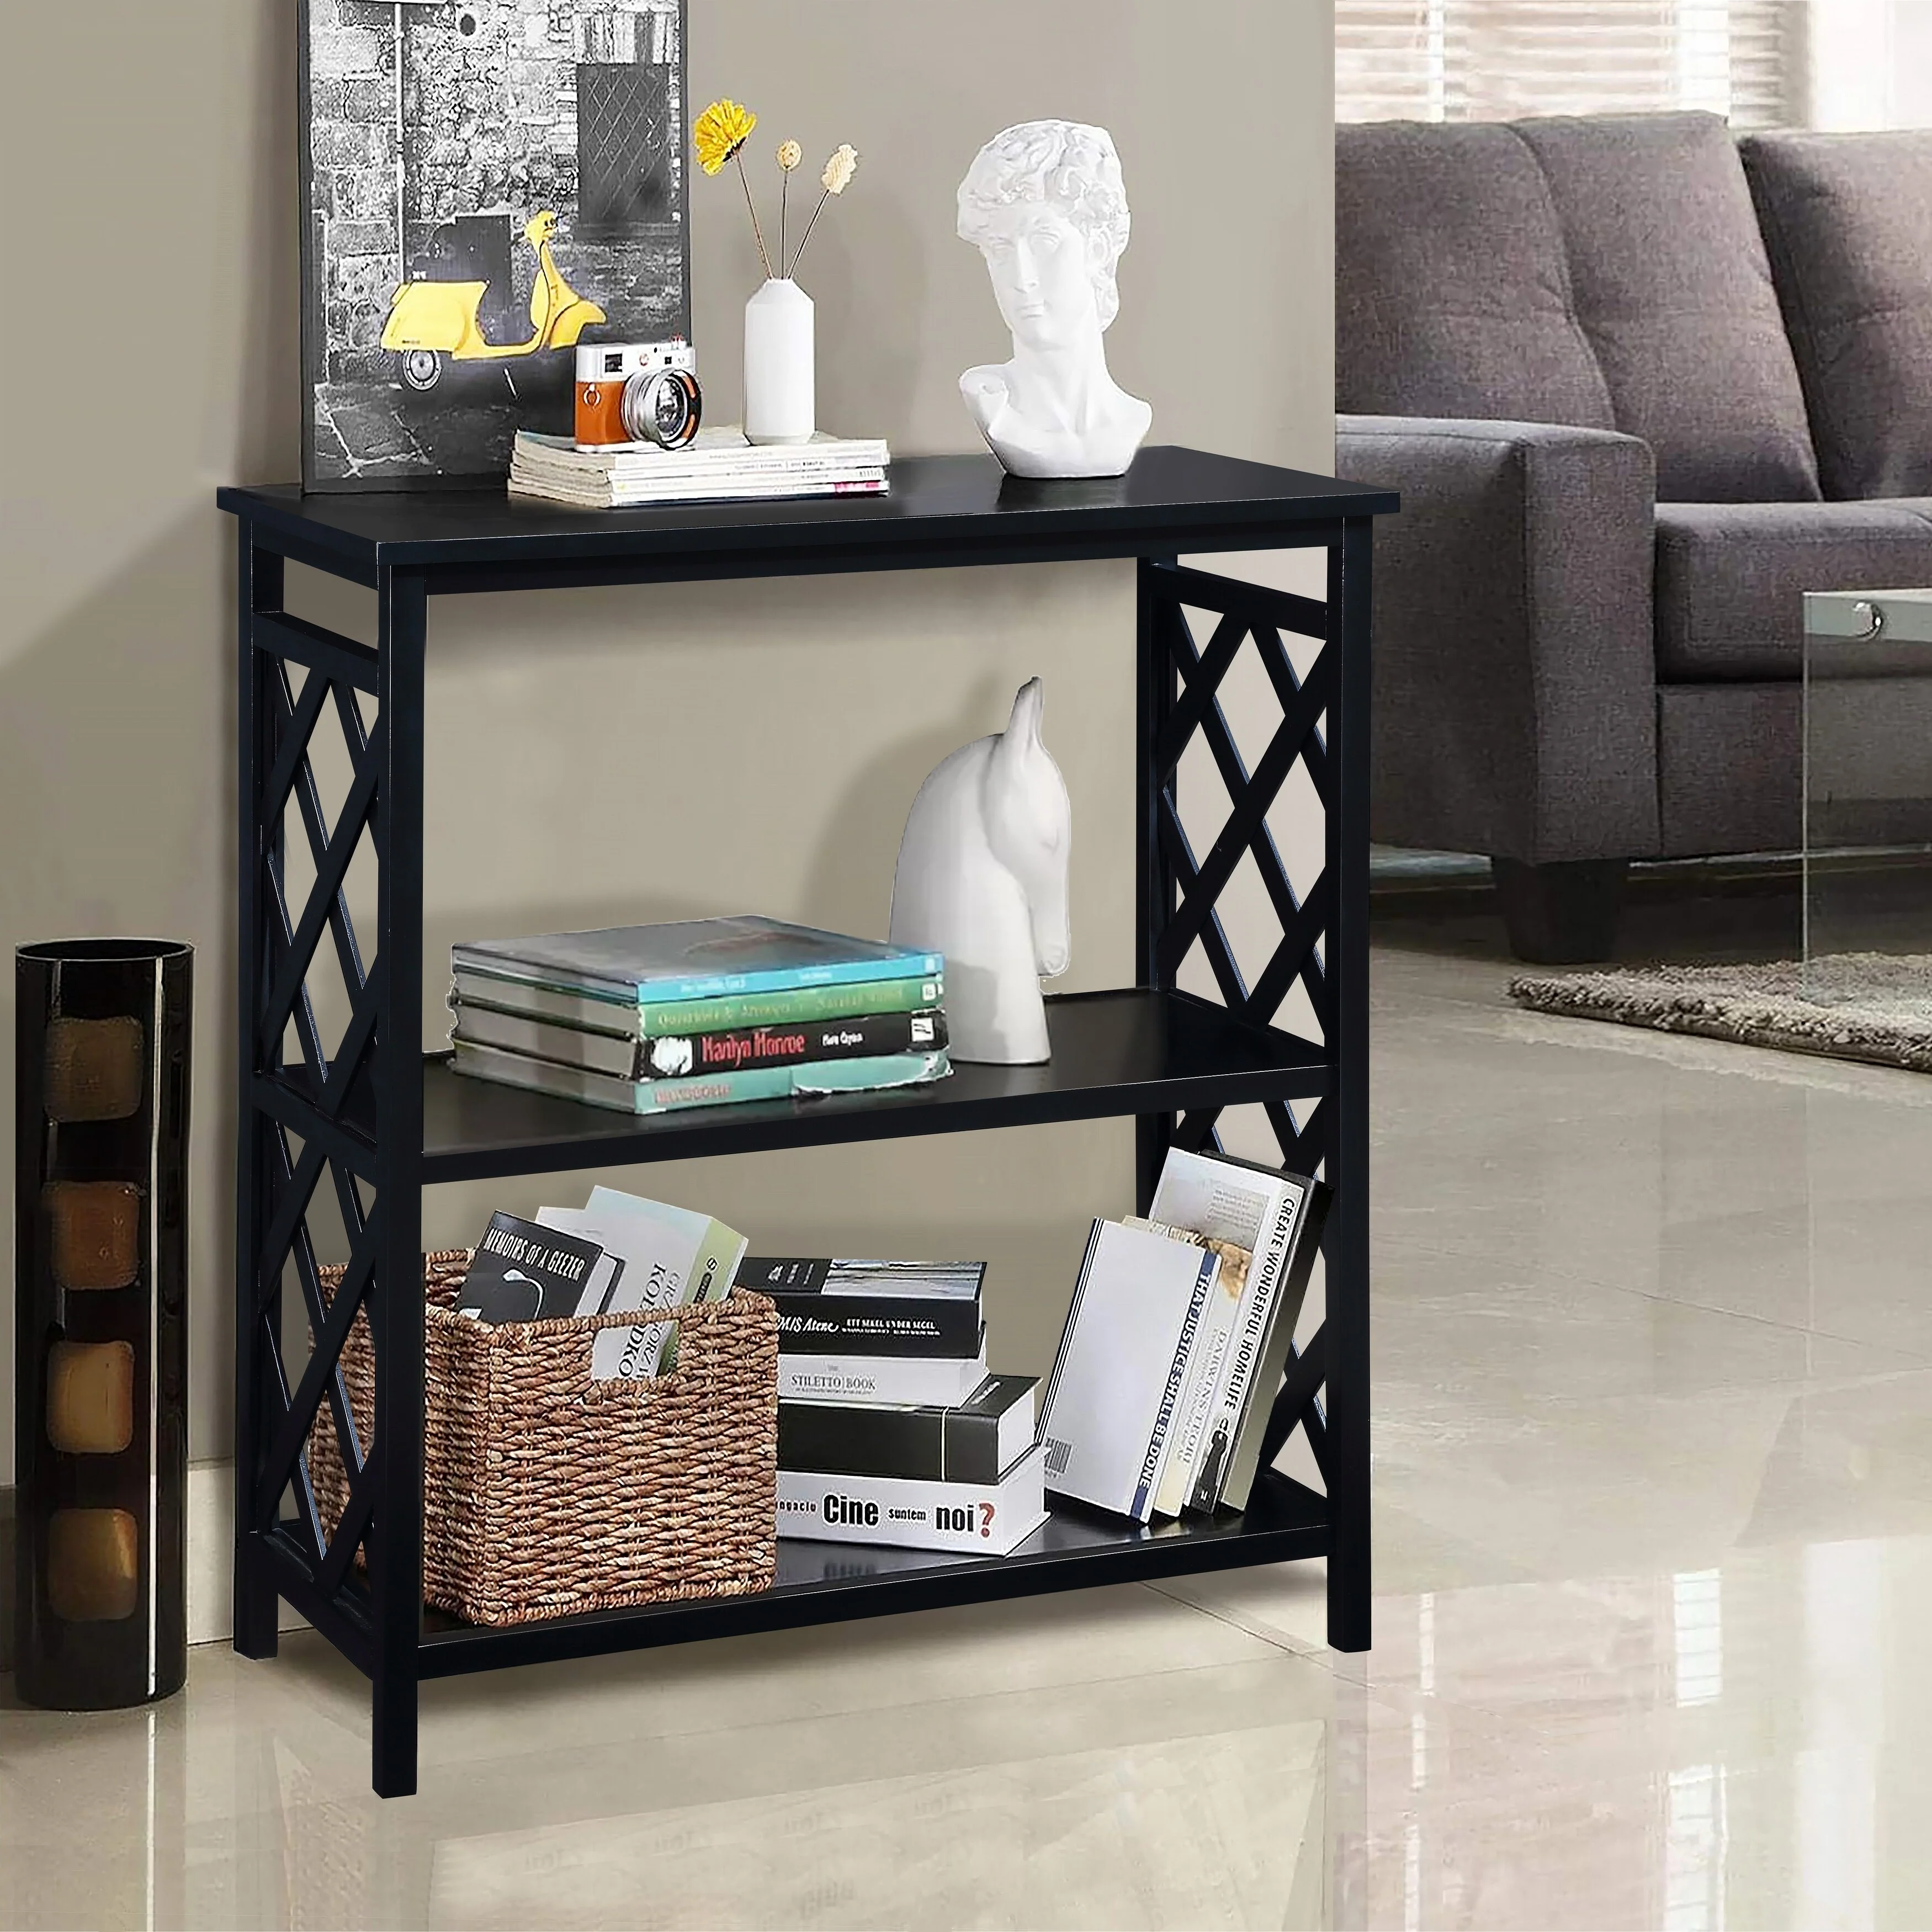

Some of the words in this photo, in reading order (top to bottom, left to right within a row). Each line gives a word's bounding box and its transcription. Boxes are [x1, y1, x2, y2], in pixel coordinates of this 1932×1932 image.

[1271, 1198, 1295, 1248] CREATE
[484, 1228, 528, 1261] MEMOIRS
[525, 1244, 542, 1265] OF
[538, 1249, 549, 1268] A
[547, 1250, 585, 1281] GEEZER
[1190, 1273, 1212, 1314] THAT
[1245, 1250, 1280, 1340] WONDERFUL
[1172, 1313, 1199, 1373] JUSTICE
[791, 1374, 841, 1388] STILETTO
[1159, 1372, 1182, 1424] SHALL
[1153, 1424, 1167, 1442] BE
[1140, 1442, 1160, 1489] DONE
[824, 1495, 879, 1526] Cine
[888, 1507, 926, 1521] suntem
